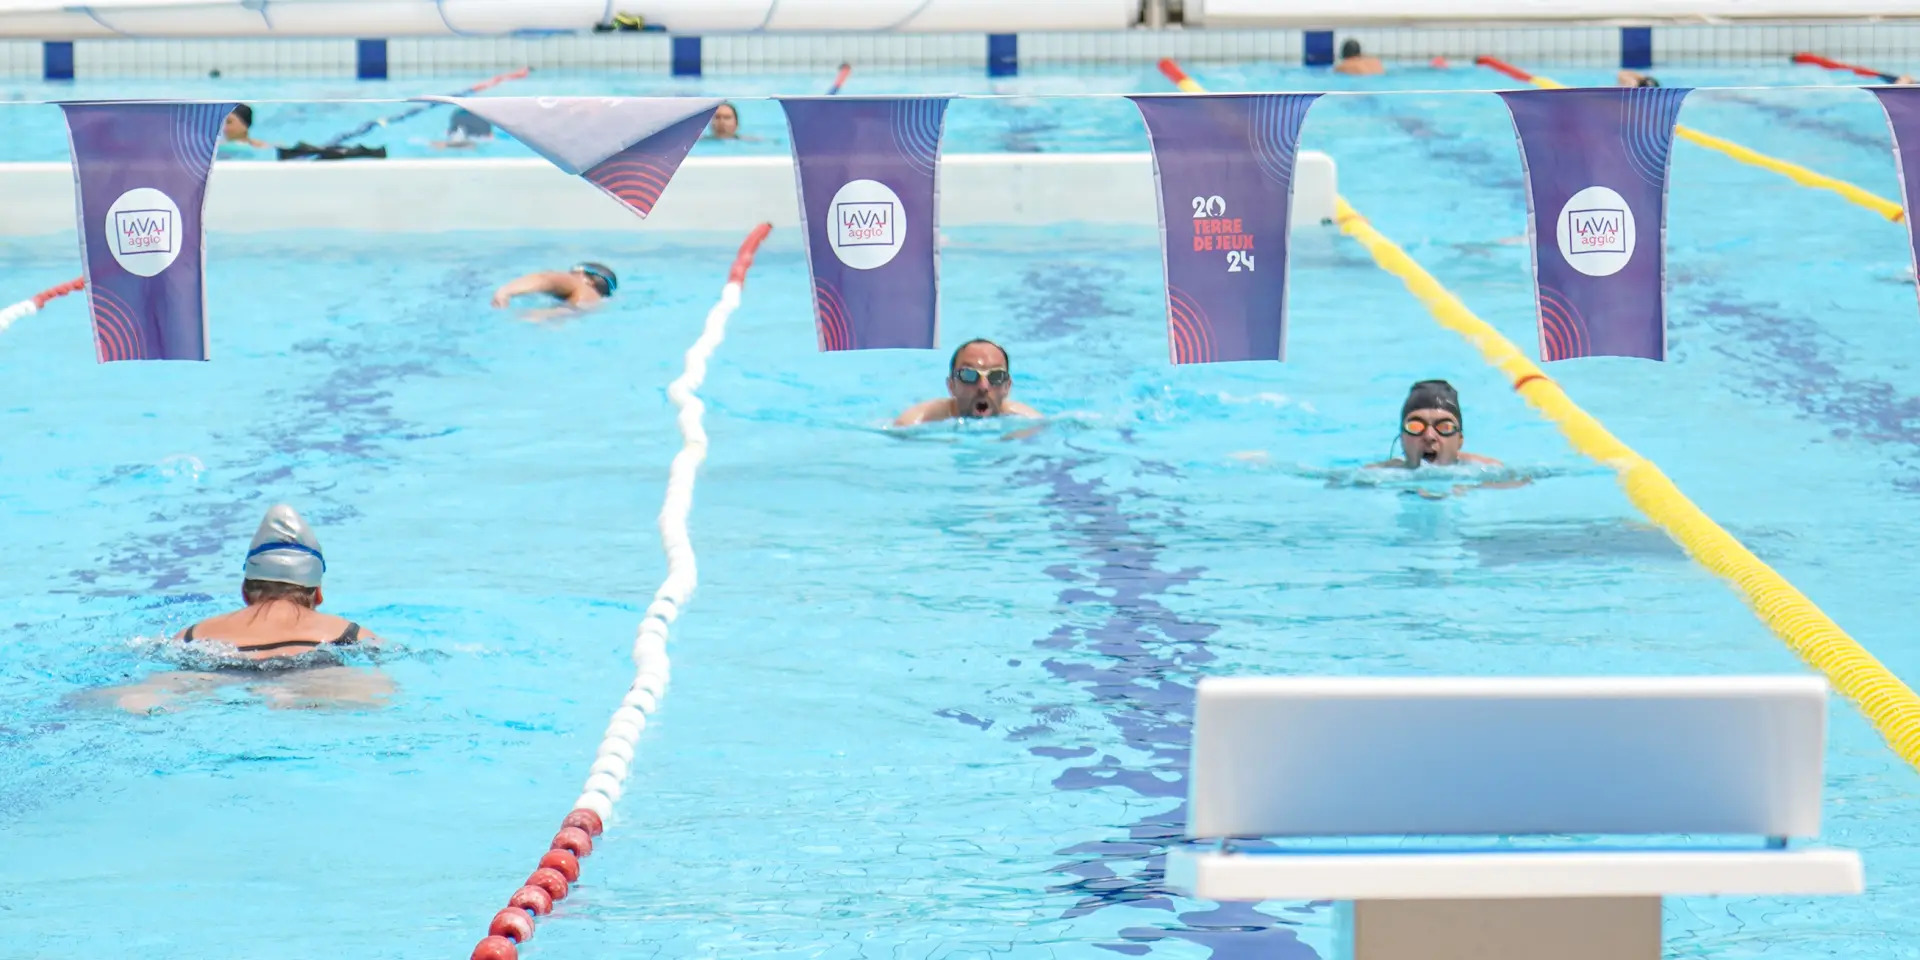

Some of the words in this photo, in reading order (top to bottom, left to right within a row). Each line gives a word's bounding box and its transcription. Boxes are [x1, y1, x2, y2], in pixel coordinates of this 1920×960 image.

[1192, 195, 1226, 218] 20
[848, 228, 883, 239] agglo
[1193, 218, 1242, 235] TERRE
[128, 236, 162, 248] agglo
[1193, 236, 1213, 252] DE
[1216, 234, 1254, 250] JEUX
[1581, 235, 1616, 246] agglo
[1226, 250, 1255, 272] 24
